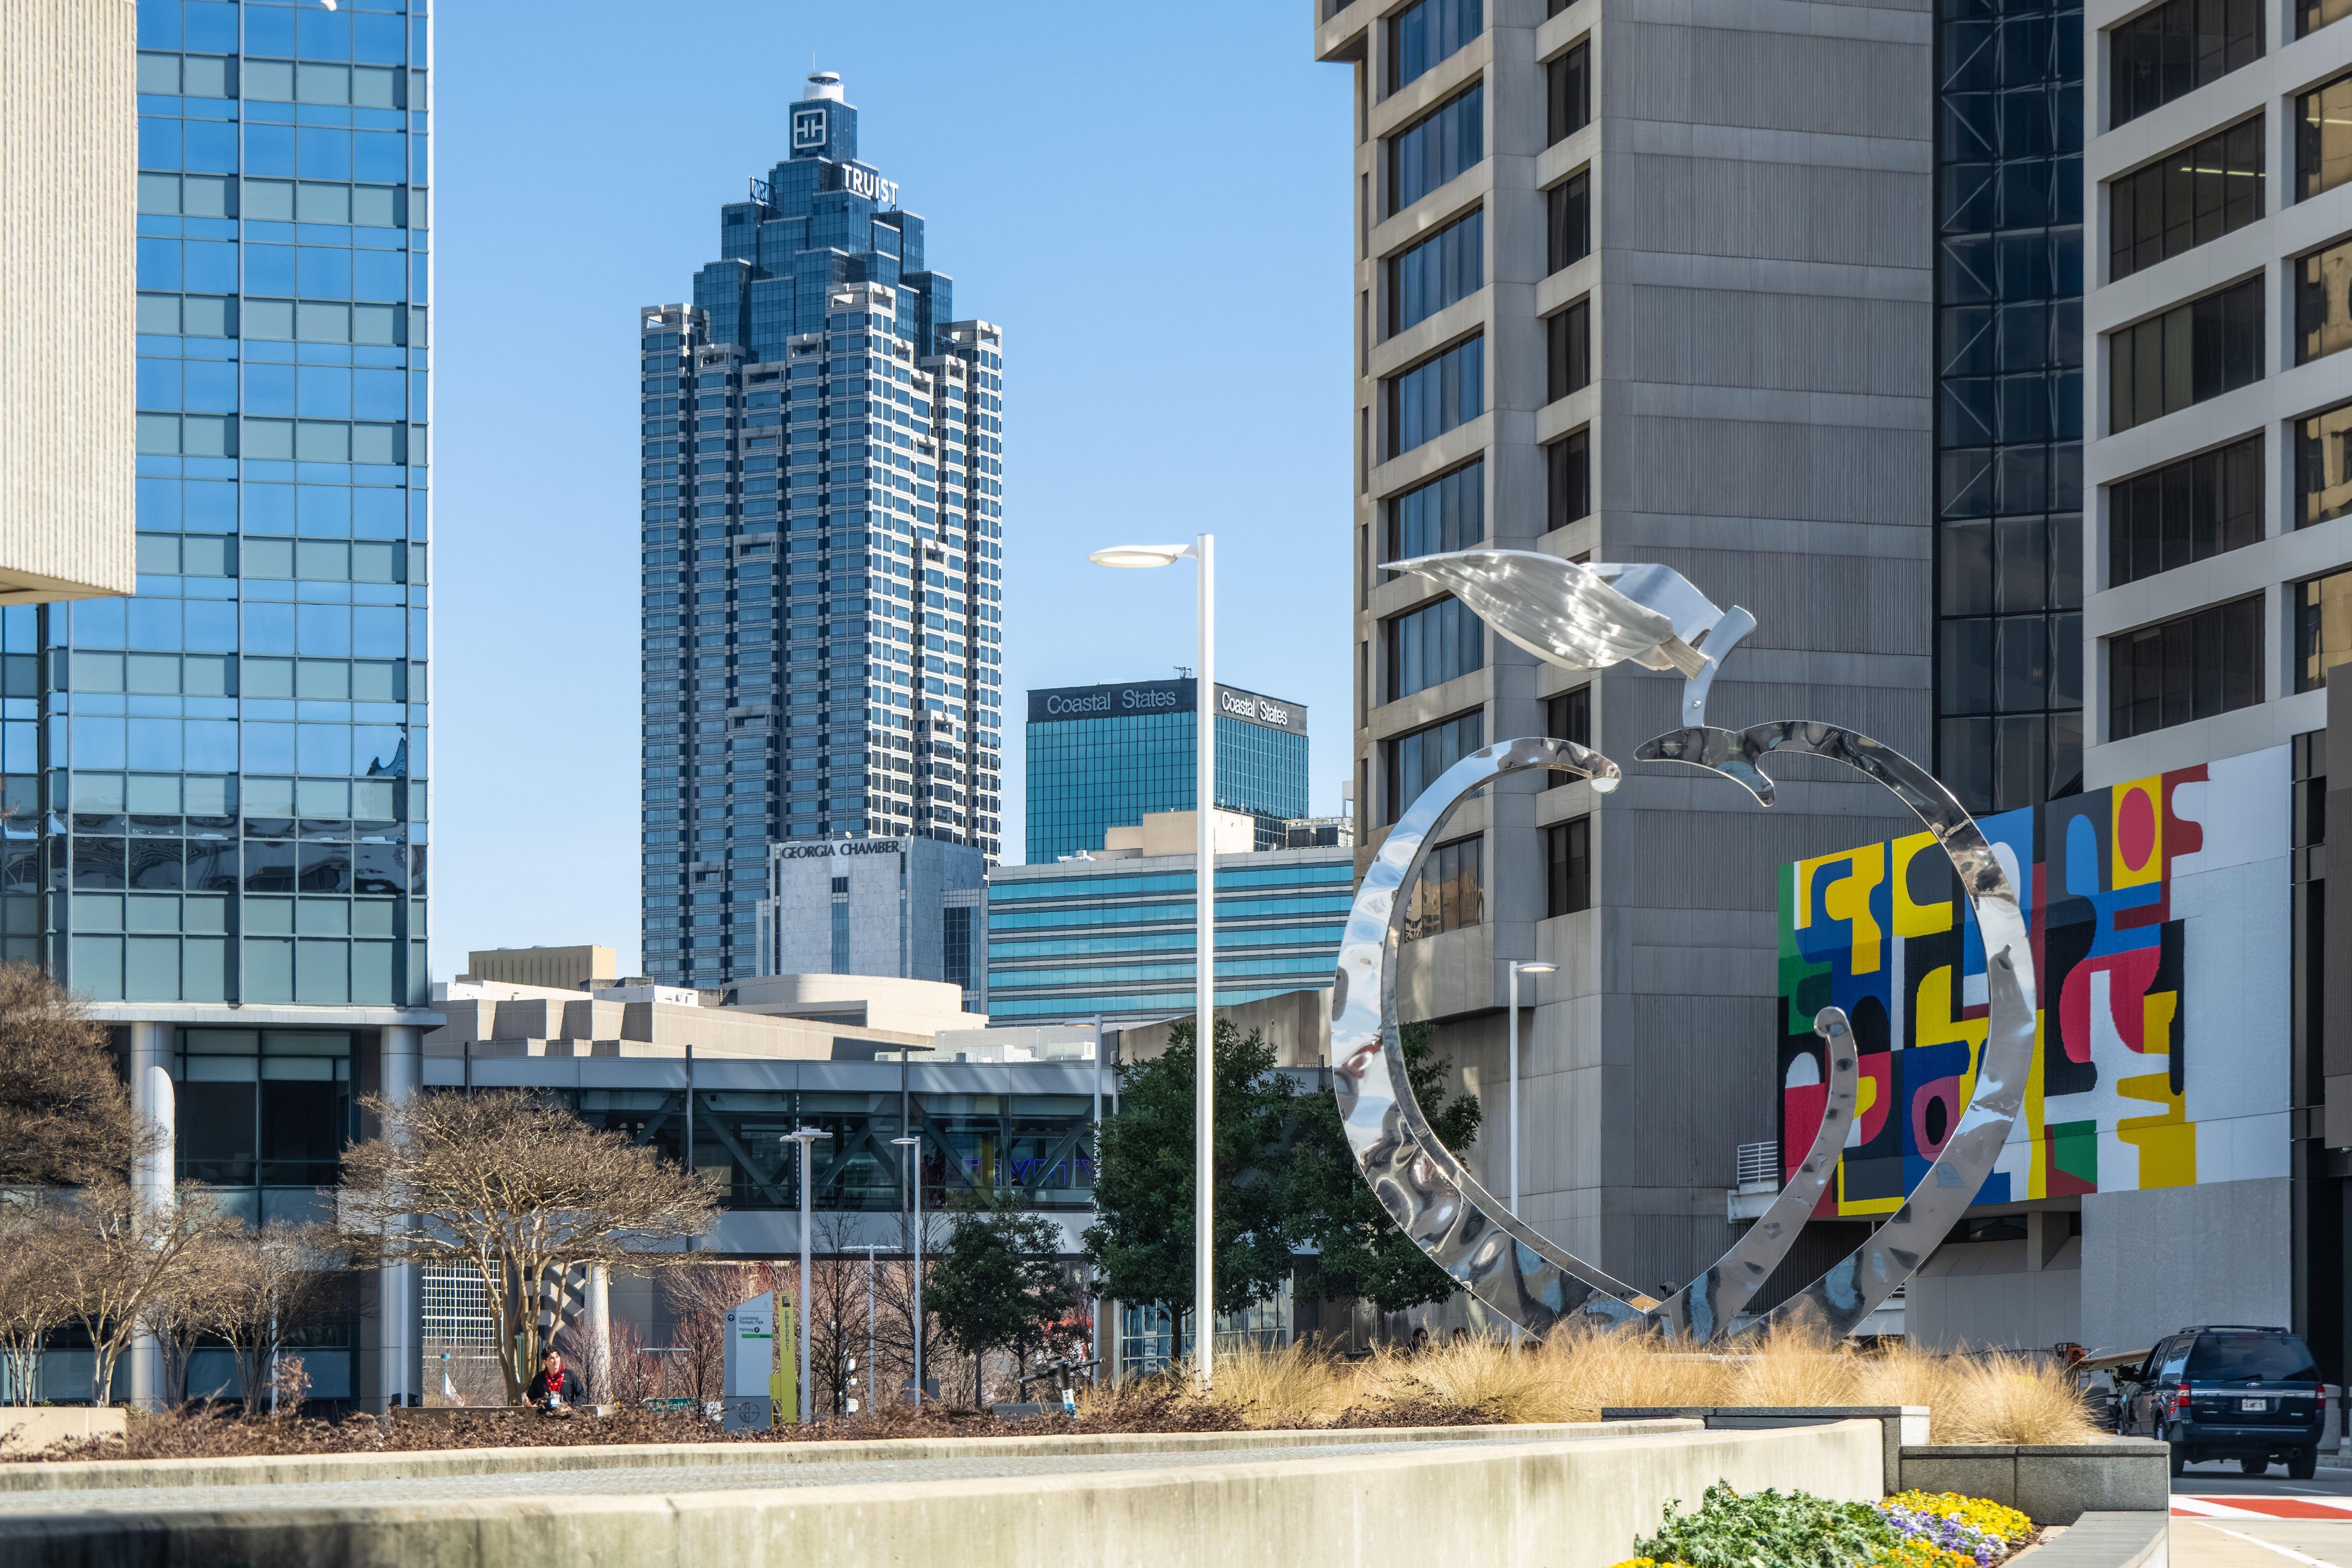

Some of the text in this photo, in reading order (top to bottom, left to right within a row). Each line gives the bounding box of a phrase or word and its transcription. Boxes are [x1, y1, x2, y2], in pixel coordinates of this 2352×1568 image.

[842, 163, 899, 205] TRUIST
[1047, 688, 1176, 714] Coastal States
[1221, 691, 1288, 725] Coastal States
[781, 840, 900, 859] GEORGIA CHAMBER
[656, 1402, 688, 1410] Mrietta
